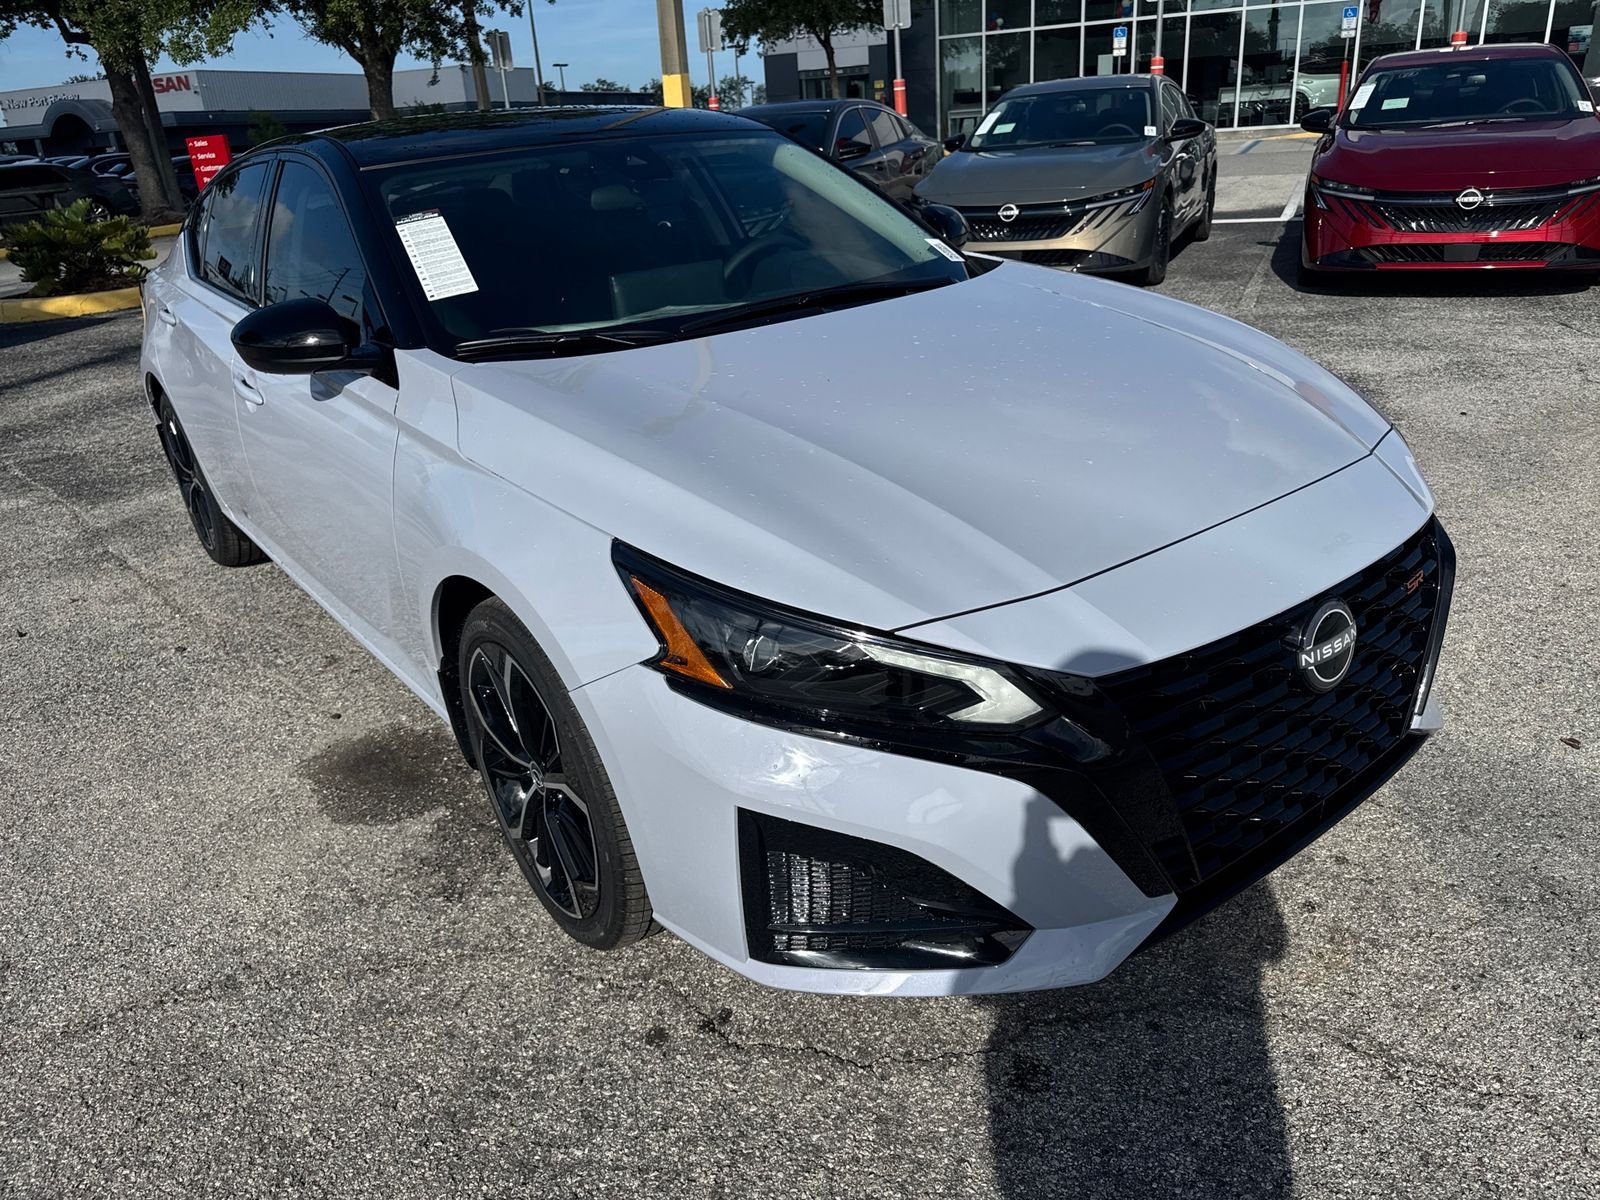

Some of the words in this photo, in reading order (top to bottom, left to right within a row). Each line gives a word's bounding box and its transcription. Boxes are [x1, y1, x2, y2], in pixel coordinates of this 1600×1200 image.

[152, 75, 191, 94] SAN
[6, 100, 28, 109] New
[28, 97, 48, 107] Port
[197, 152, 216, 160] Service
[1407, 570, 1424, 595] SR
[1301, 627, 1358, 667] NISSAN
